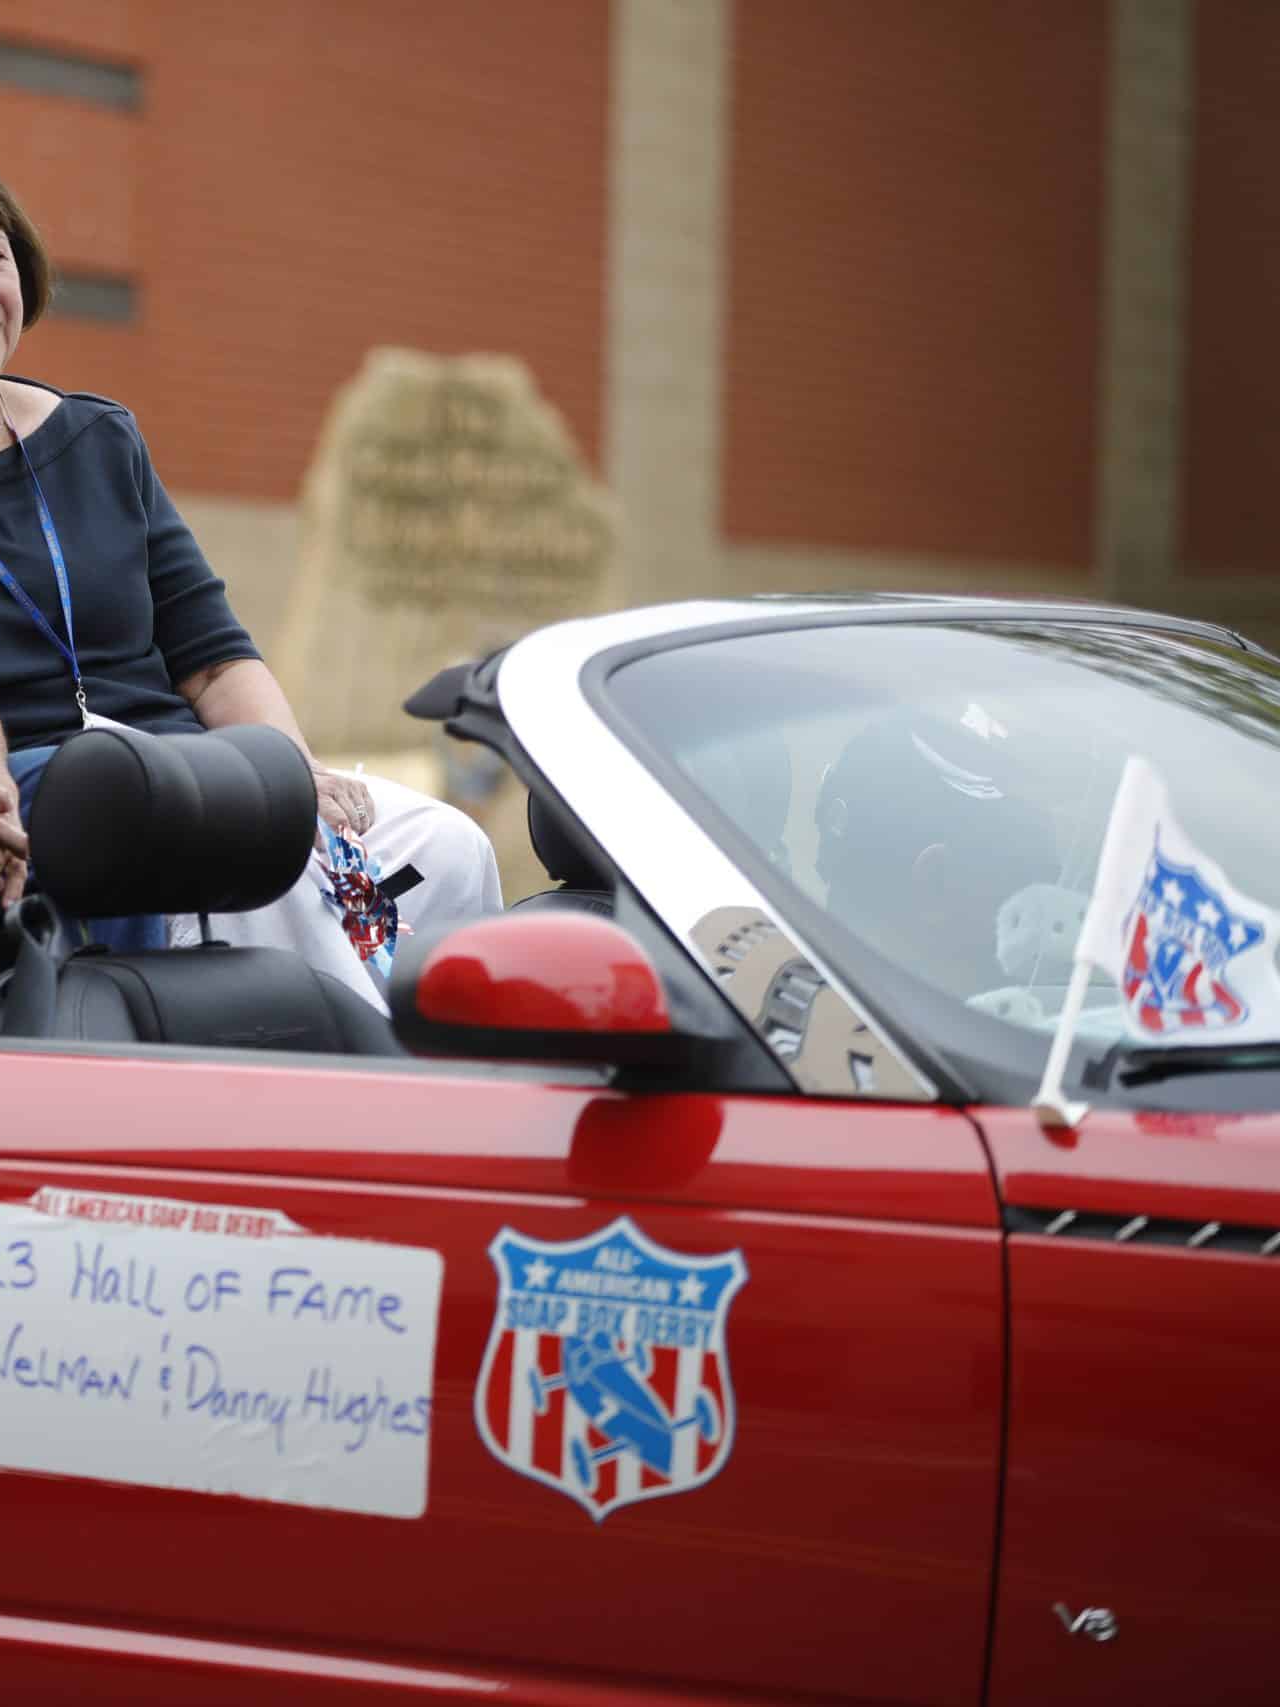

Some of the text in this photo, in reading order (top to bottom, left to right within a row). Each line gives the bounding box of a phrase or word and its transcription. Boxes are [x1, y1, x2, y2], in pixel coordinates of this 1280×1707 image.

[67, 1196, 145, 1224] AMERICAN
[150, 1204, 189, 1230] SOAP
[555, 1268, 671, 1303] AMERICAN
[507, 1296, 568, 1330] SOAP
[634, 1308, 714, 1350] DERBY
[186, 1344, 289, 1455] Danny
[302, 1366, 432, 1452] Hughes
